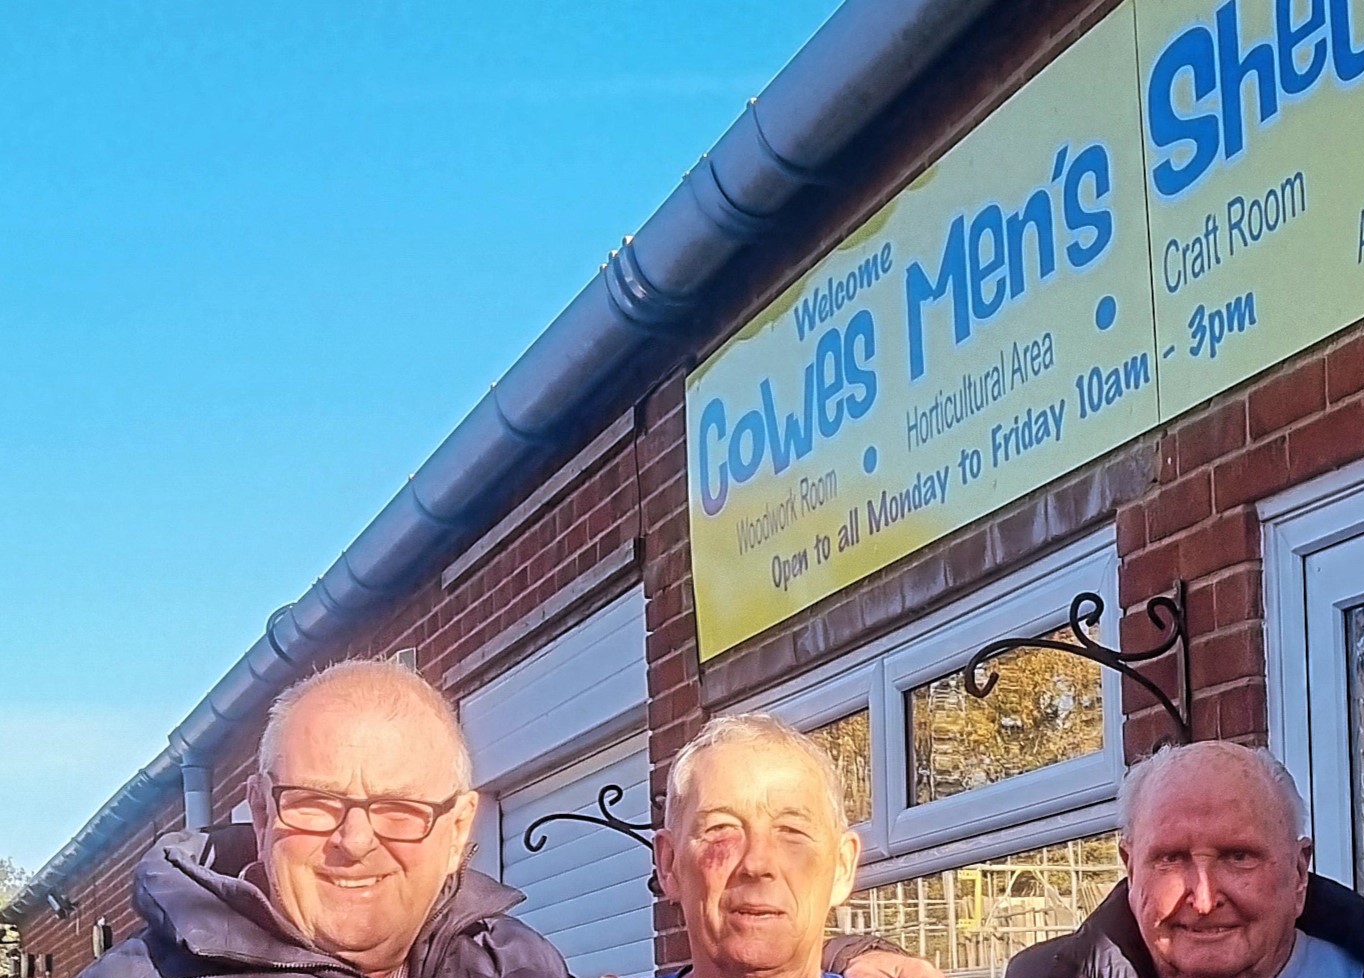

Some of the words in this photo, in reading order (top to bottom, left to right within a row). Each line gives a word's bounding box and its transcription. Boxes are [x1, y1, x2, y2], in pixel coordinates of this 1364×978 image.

[700, 310, 876, 516] Cowes
[906, 144, 1113, 382] Men's
[737, 487, 798, 555] Woodwork
[800, 469, 838, 517] Room
[906, 350, 1006, 452] Horticultural
[1011, 331, 1054, 391] Area
[1164, 213, 1221, 293] Craft
[1227, 171, 1306, 256] Room
[771, 551, 808, 592] Open
[814, 533, 831, 565] to
[838, 507, 860, 553] all
[867, 465, 949, 536] Monday
[958, 448, 981, 485] to
[991, 399, 1065, 468] Friday
[1075, 352, 1151, 419] 10am
[1188, 292, 1257, 359] 3pm
[794, 242, 893, 341] Welcome
